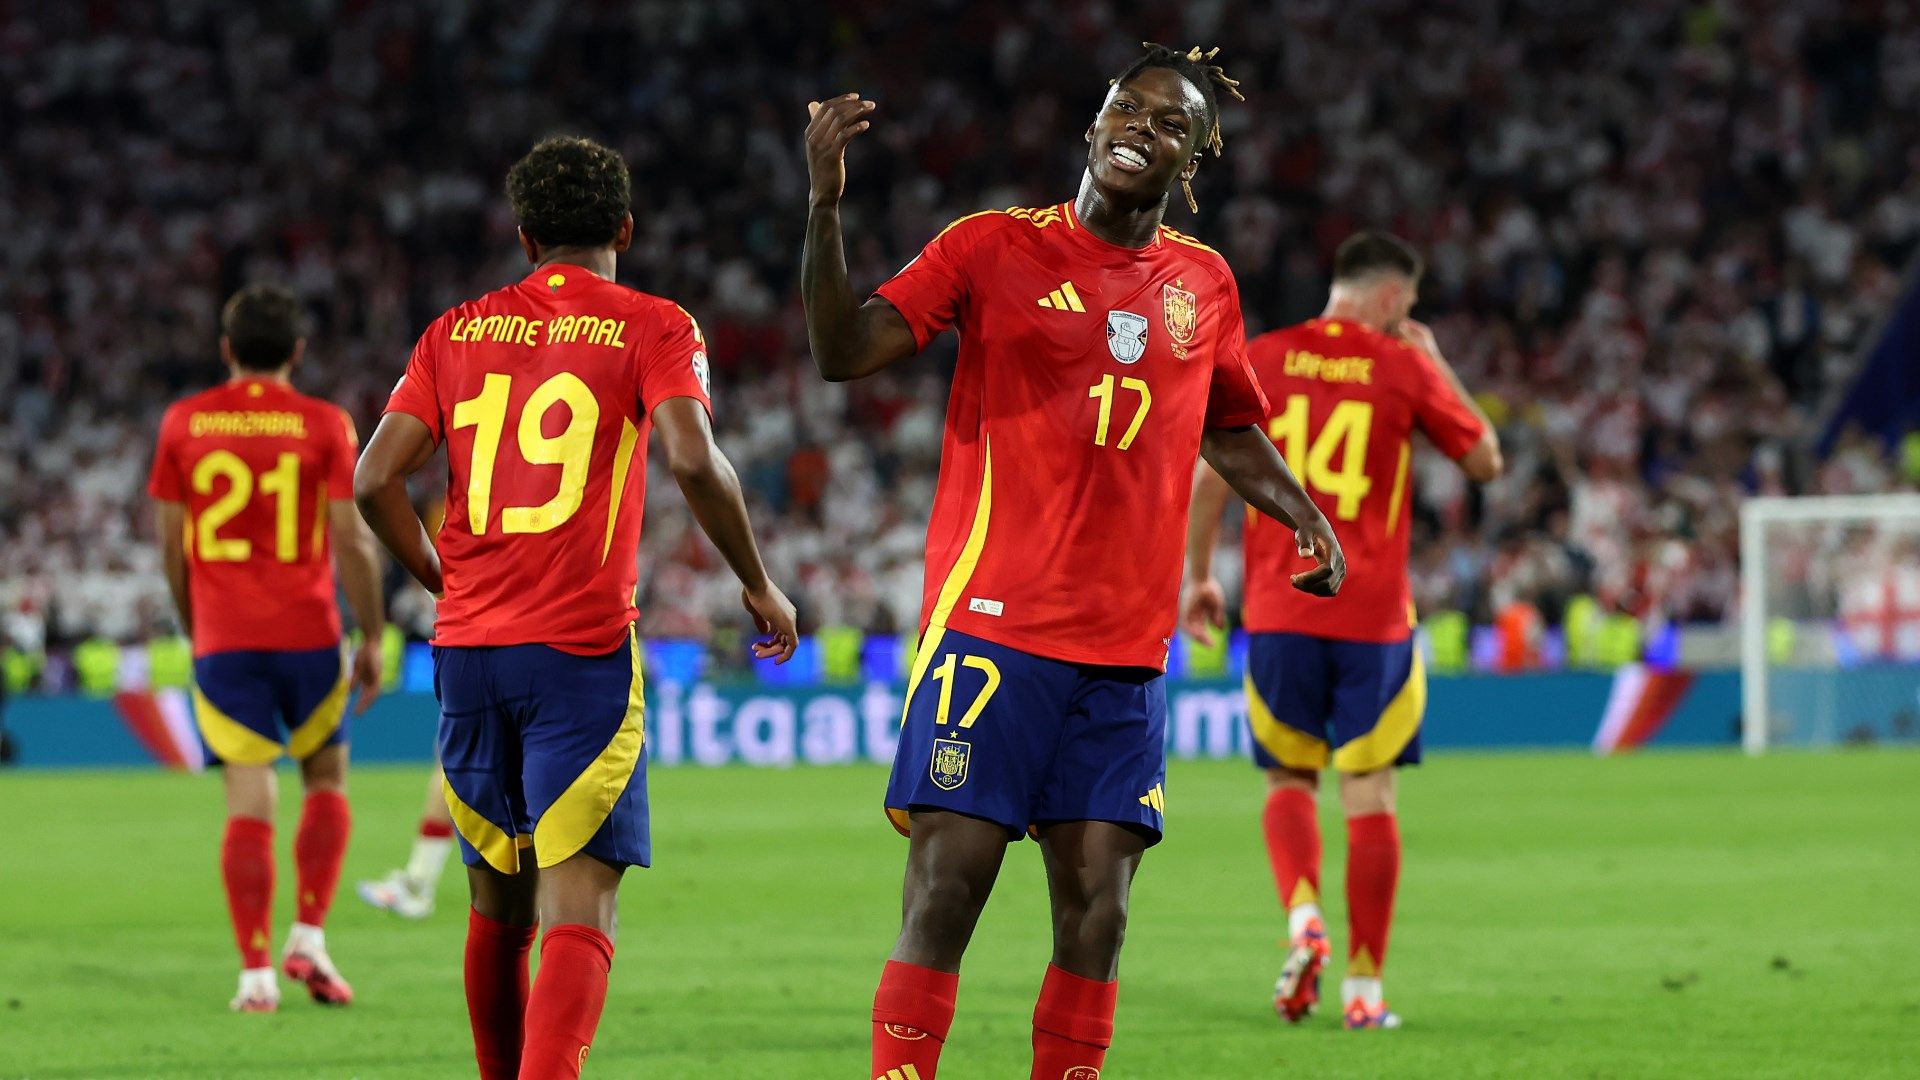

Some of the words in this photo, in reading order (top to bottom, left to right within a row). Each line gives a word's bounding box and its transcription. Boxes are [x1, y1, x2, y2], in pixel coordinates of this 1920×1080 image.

[450, 314, 543, 347] LAMINE
[547, 314, 626, 349] YAMAL
[453, 372, 600, 535] 19
[1089, 374, 1152, 451] 17
[1269, 394, 1374, 521] 14
[192, 450, 300, 563] 21
[932, 653, 1001, 729] 17
